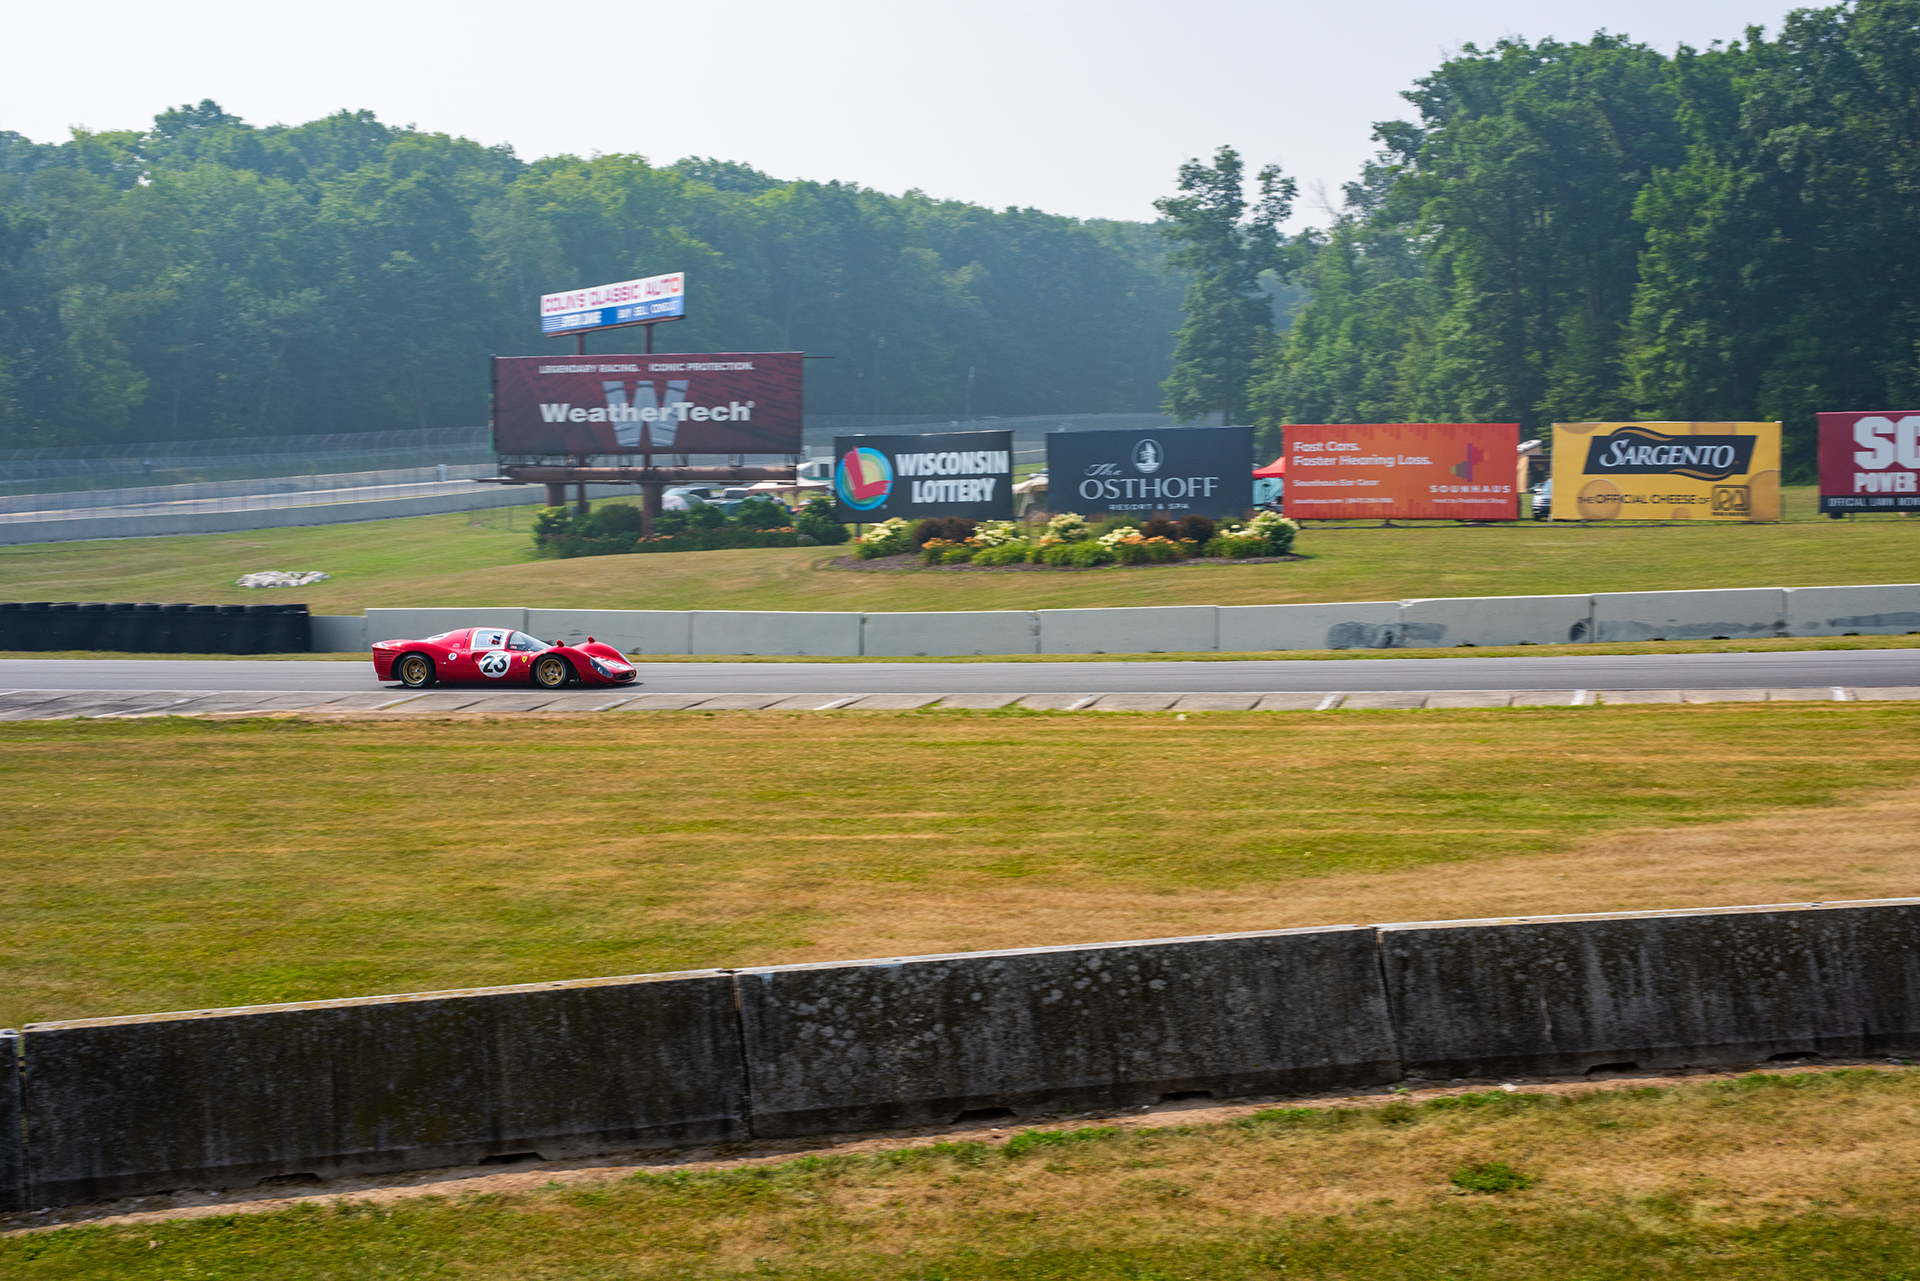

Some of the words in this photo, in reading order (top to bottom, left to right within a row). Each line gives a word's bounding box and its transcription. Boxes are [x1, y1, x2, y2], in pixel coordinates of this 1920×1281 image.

[590, 285, 641, 306] CLASSIC
[644, 277, 681, 296] AUTO
[539, 365, 598, 374] LEGENDARY
[648, 363, 686, 372] ICONIC
[1292, 441, 1324, 452] Fast
[1325, 441, 1361, 452] Cars.
[1599, 439, 1735, 468] SARGENTO
[895, 450, 1009, 476] WISCONSIN
[1292, 455, 1338, 466] Faster
[1338, 454, 1395, 468] Hearing
[1397, 455, 1433, 466] Loss.
[1083, 463, 1124, 476] The
[1079, 477, 1219, 500] OSTHOFF
[1429, 485, 1511, 493] SOUNHAUS
[1853, 472, 1918, 493] POWER
[911, 477, 997, 503] LOTTERY
[1594, 494, 1649, 504] OFFICIAL
[1649, 494, 1698, 504] CHEESE
[1827, 497, 1867, 506] OFFICIAL
[1108, 503, 1154, 511] RESORT
[482, 655, 507, 673] 23
